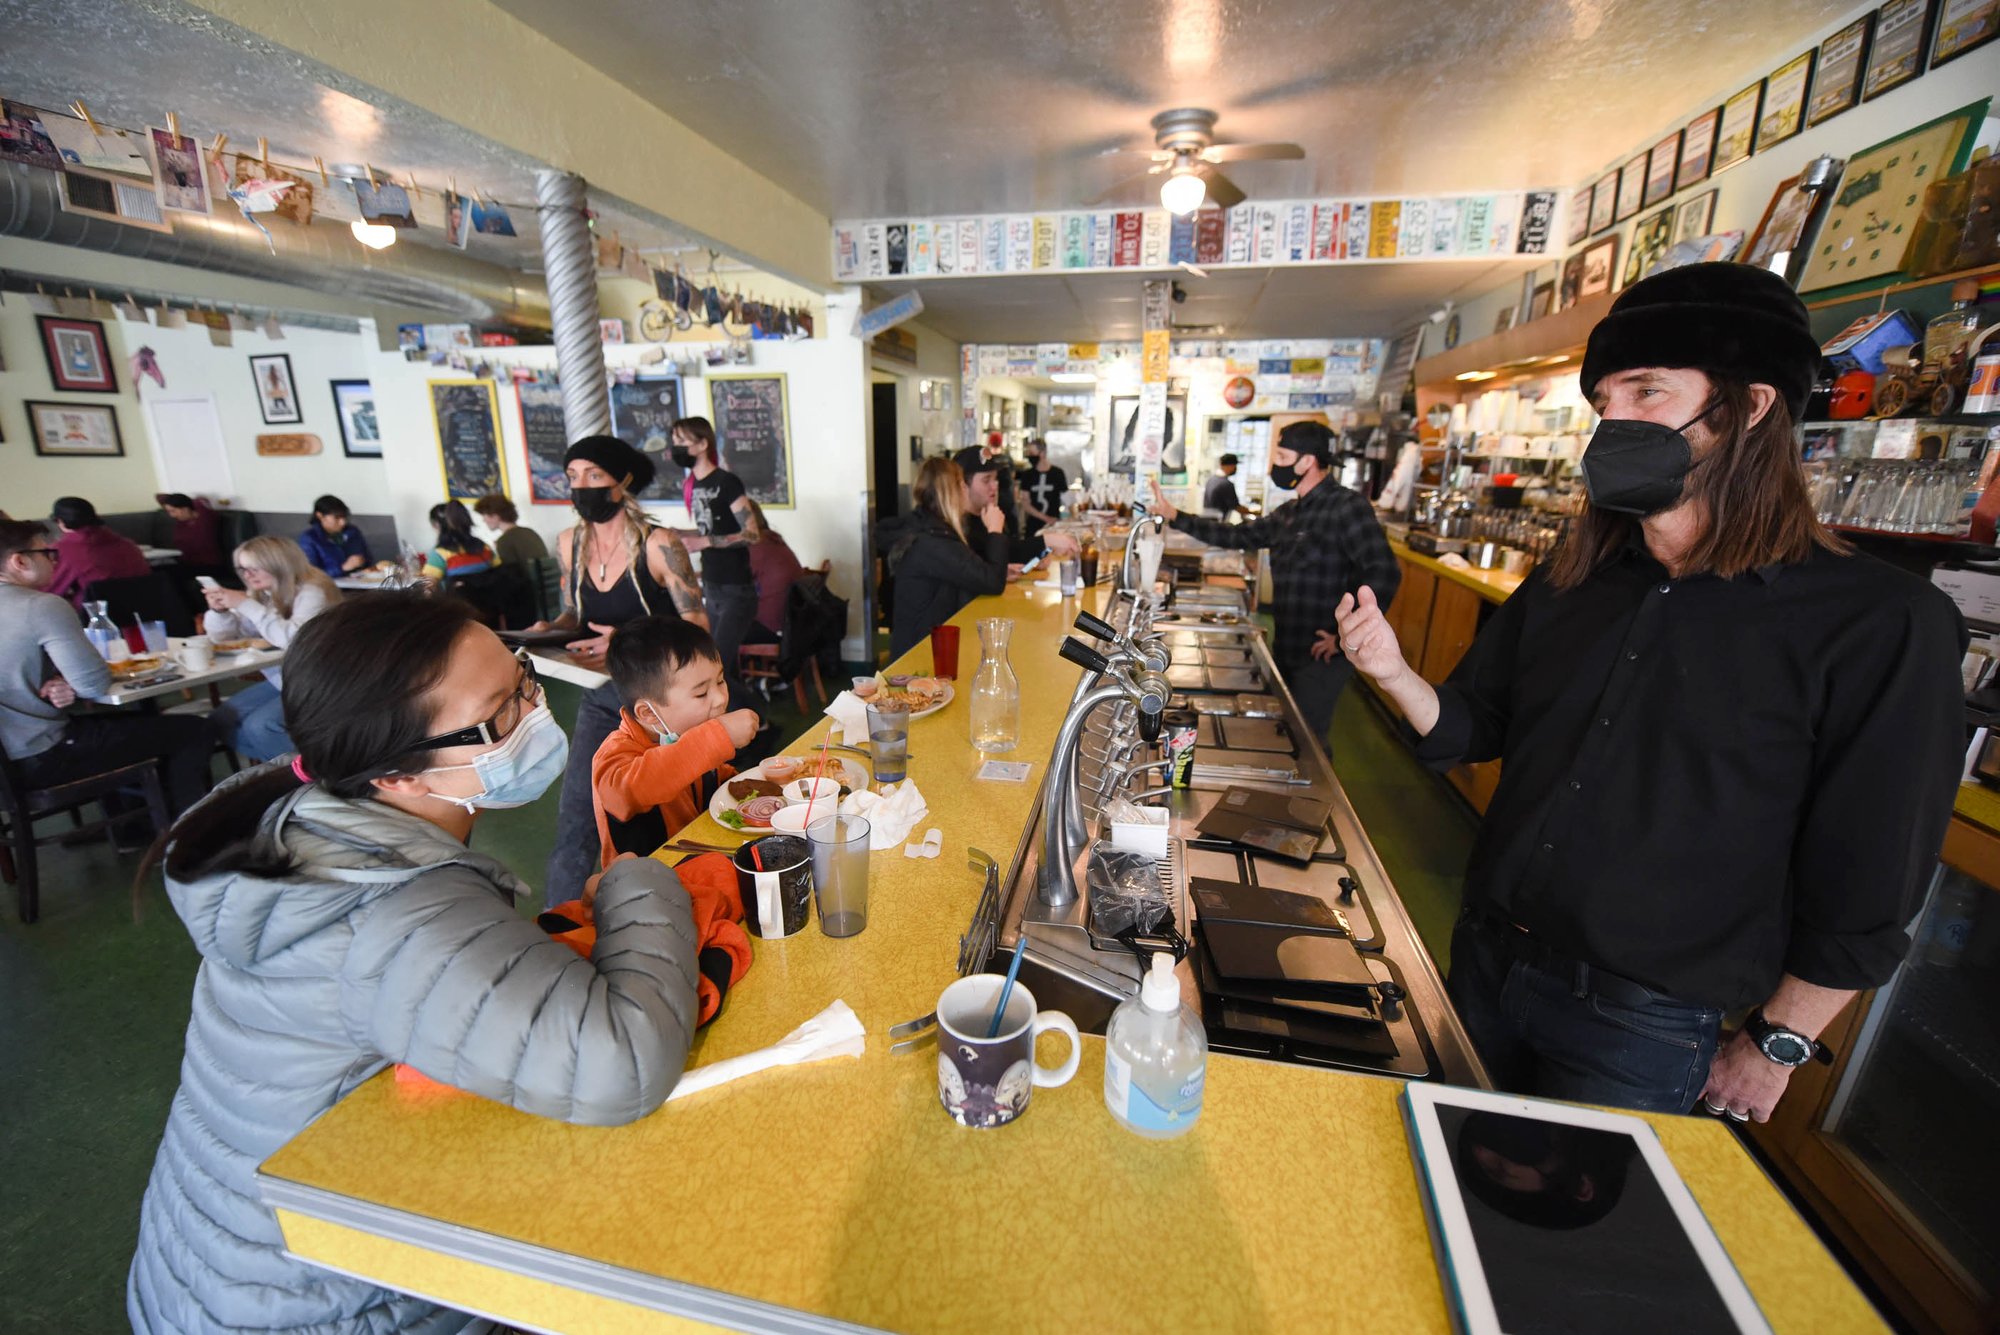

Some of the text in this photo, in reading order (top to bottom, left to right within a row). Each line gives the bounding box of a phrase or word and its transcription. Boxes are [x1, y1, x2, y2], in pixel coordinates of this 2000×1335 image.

[1914, 164, 1927, 177] 2
[1905, 193, 1917, 207] 3
[1892, 224, 1902, 235] 4
[1828, 259, 1838, 271] 7
